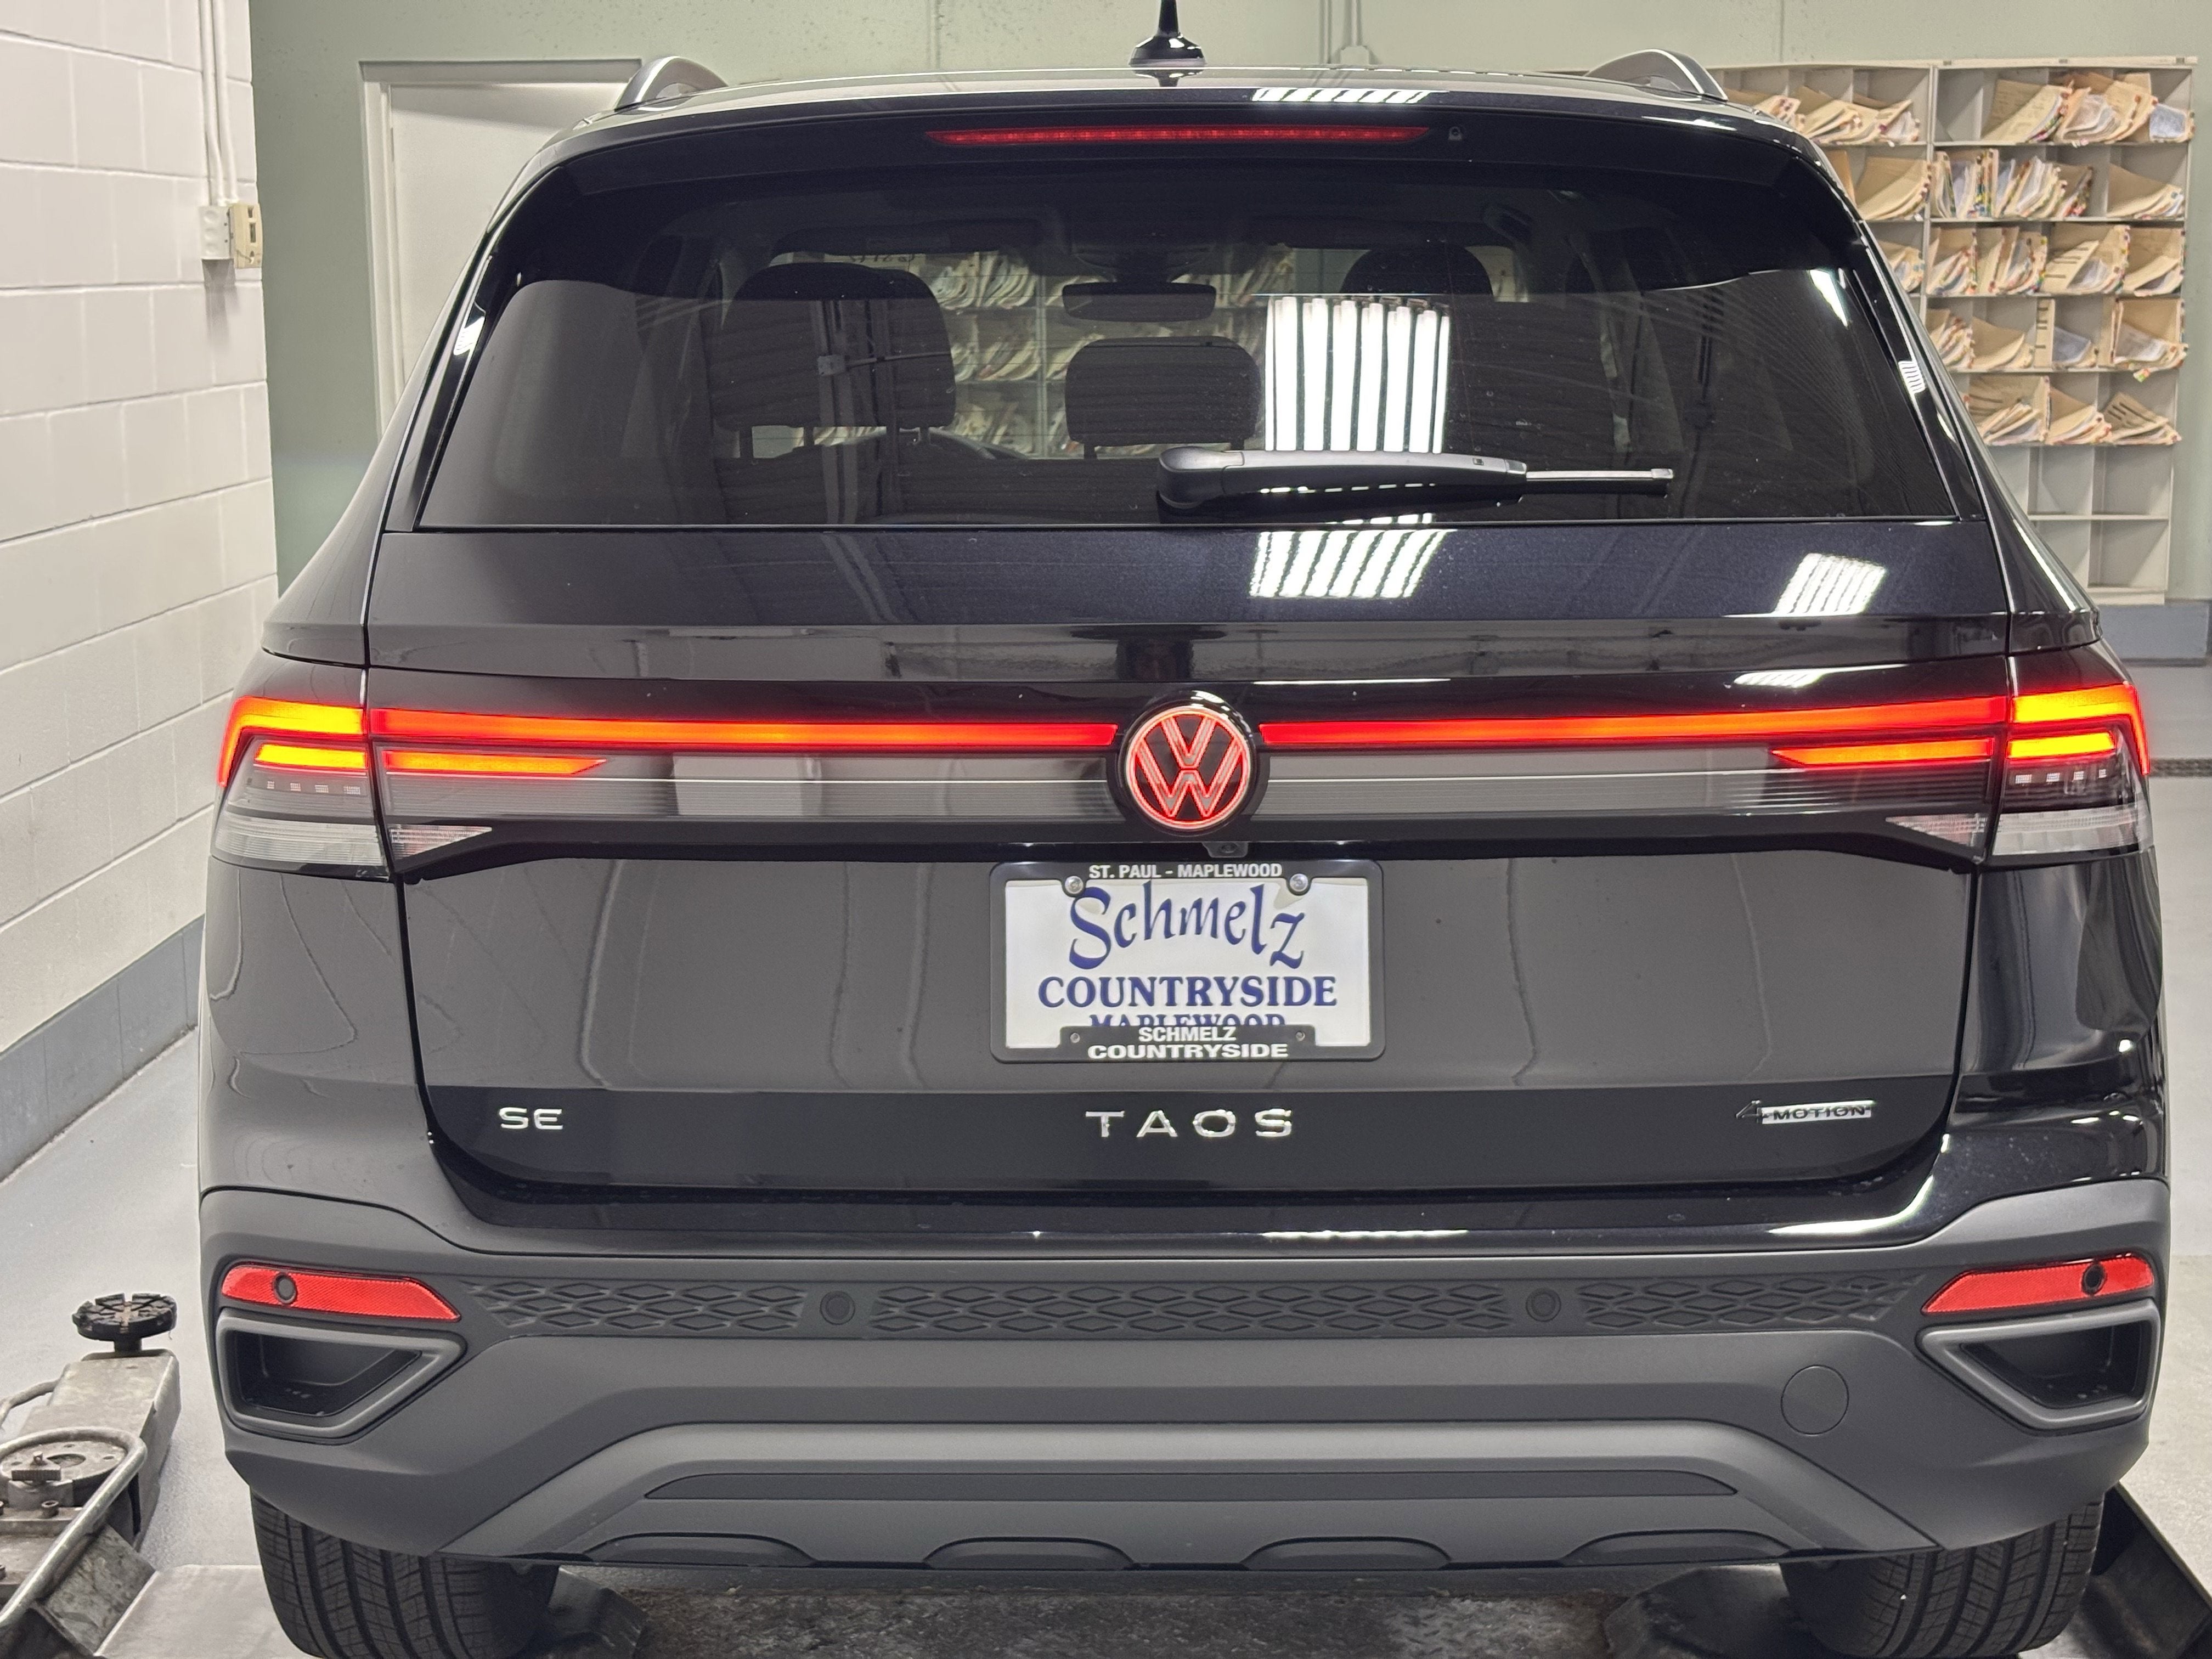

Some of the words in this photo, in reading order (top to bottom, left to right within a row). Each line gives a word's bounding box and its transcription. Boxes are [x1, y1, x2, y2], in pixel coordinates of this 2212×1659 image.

[1088, 865, 1115, 878] ST.
[1119, 865, 1161, 878] PAUL
[1177, 864, 1282, 877] MAPLEWOOD
[1069, 881, 1305, 969] Schmelz
[1038, 975, 1338, 1008] COUNTRYSIDE
[1138, 1026, 1237, 1042] SCHMELZ
[1087, 1043, 1288, 1059] COUNTRYSIDE
[499, 1107, 563, 1130] SE
[1085, 1109, 1292, 1137] TAOS
